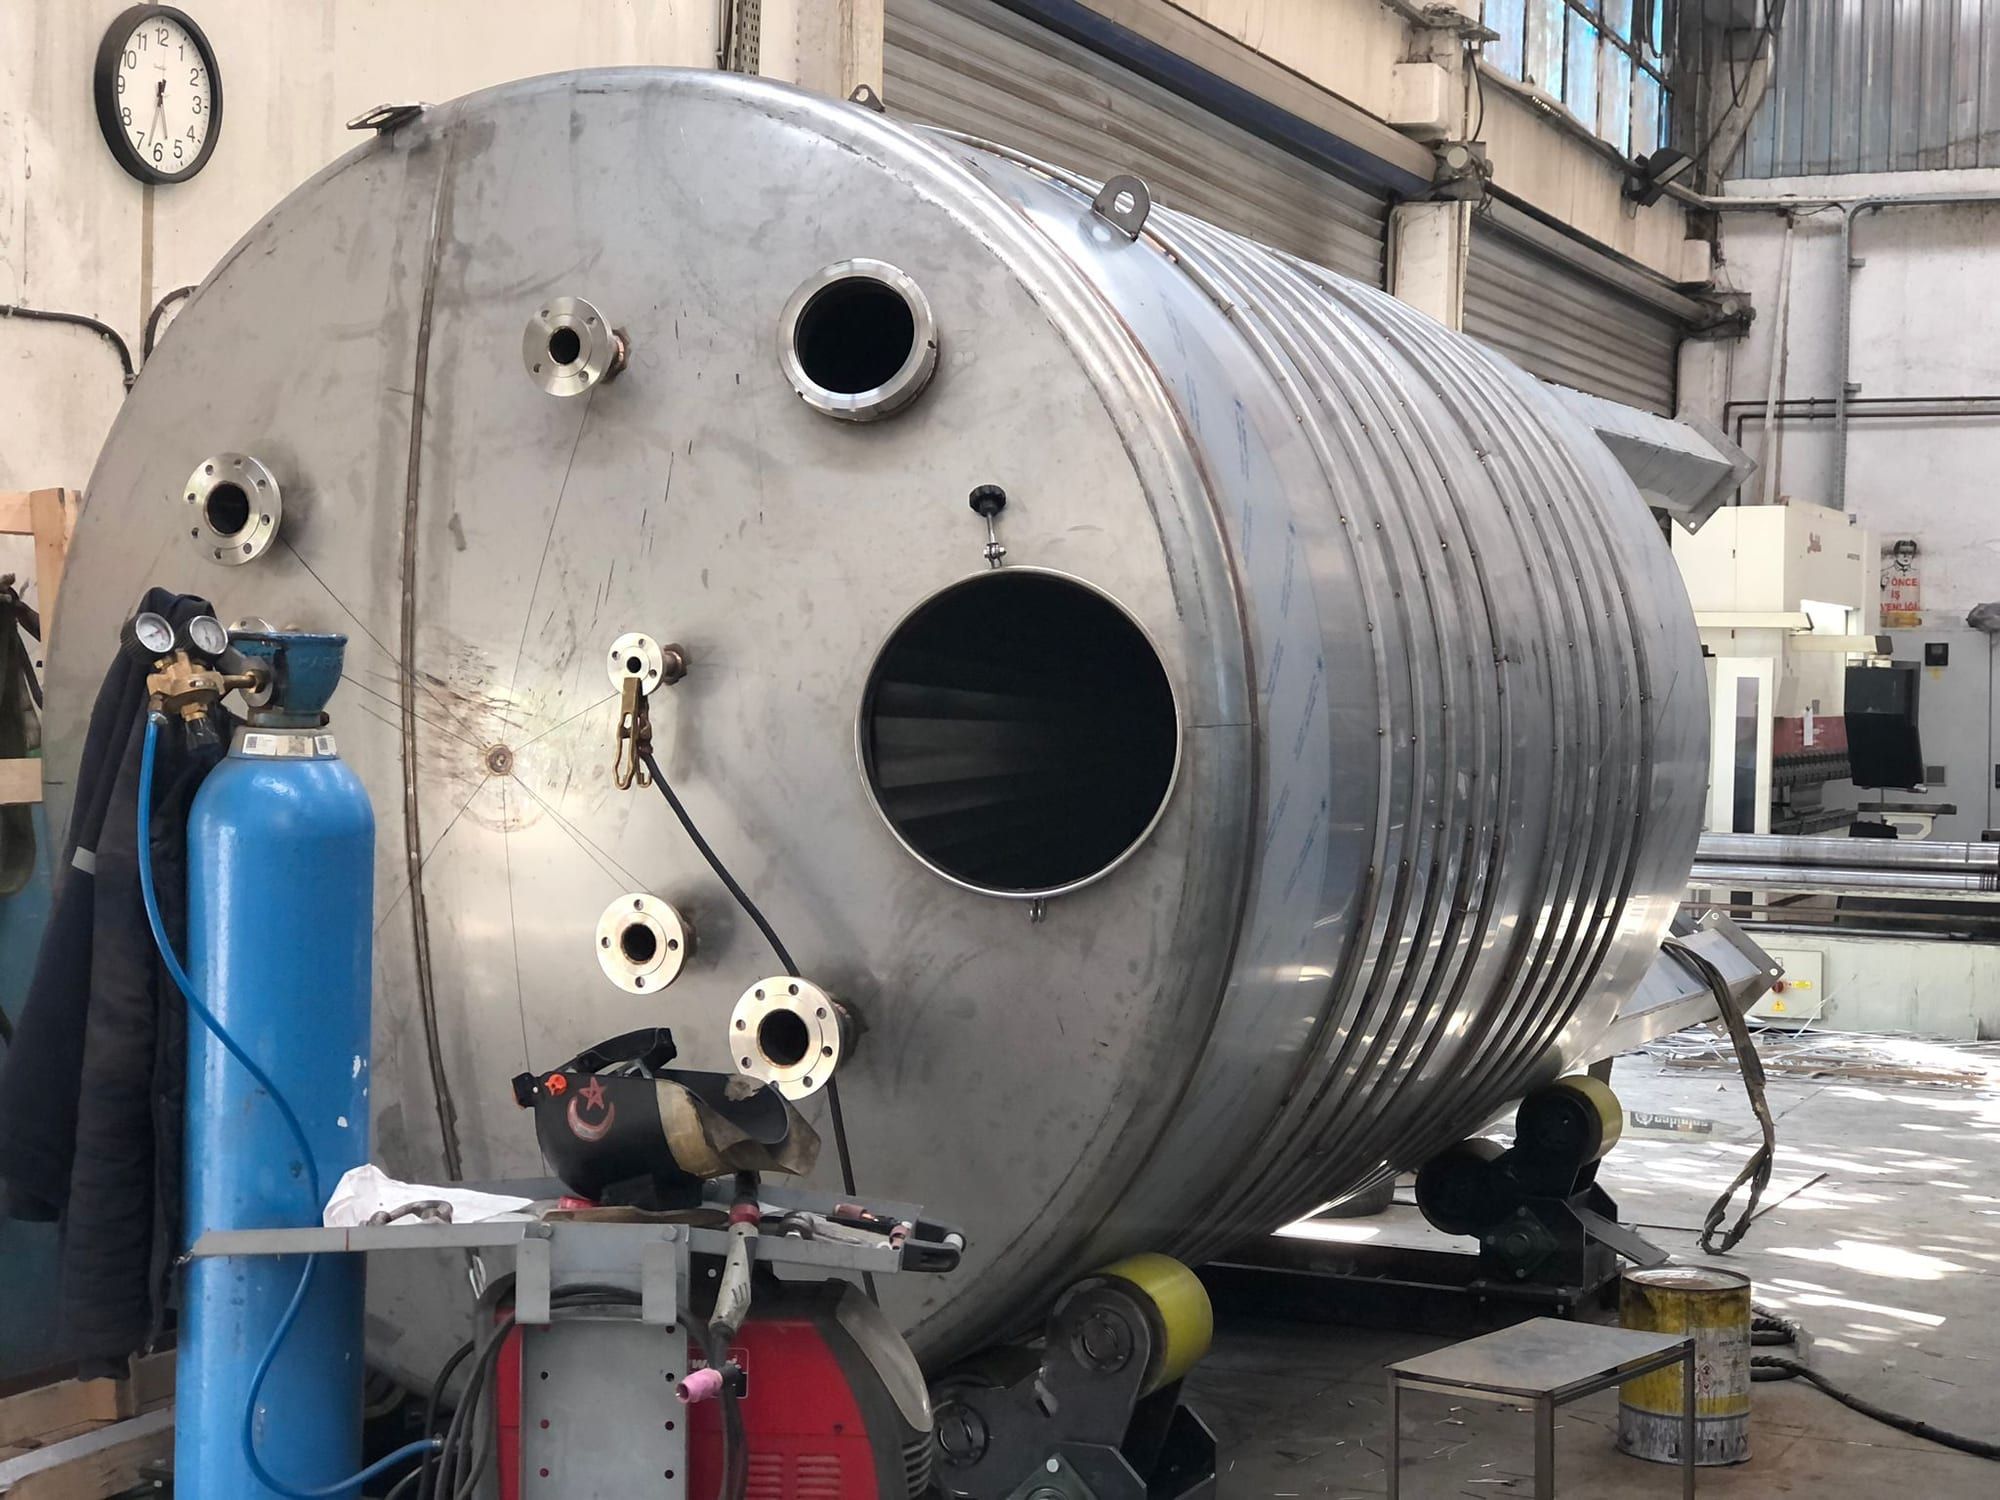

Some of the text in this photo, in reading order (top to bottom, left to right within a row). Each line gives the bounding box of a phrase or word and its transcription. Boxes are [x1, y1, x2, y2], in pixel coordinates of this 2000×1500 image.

[136, 32, 147, 51] 11
[155, 27, 169, 47] 12
[123, 50, 136, 69] 10
[179, 44, 184, 61] 1
[117, 75, 125, 94] 9
[190, 68, 199, 87] 2
[192, 95, 202, 114] 3
[121, 107, 132, 126] 8
[136, 131, 145, 149] 7
[187, 125, 195, 143] 4
[153, 143, 163, 162] 6
[173, 140, 183, 158] 5
[1891, 576, 1917, 586] ÖNCE
